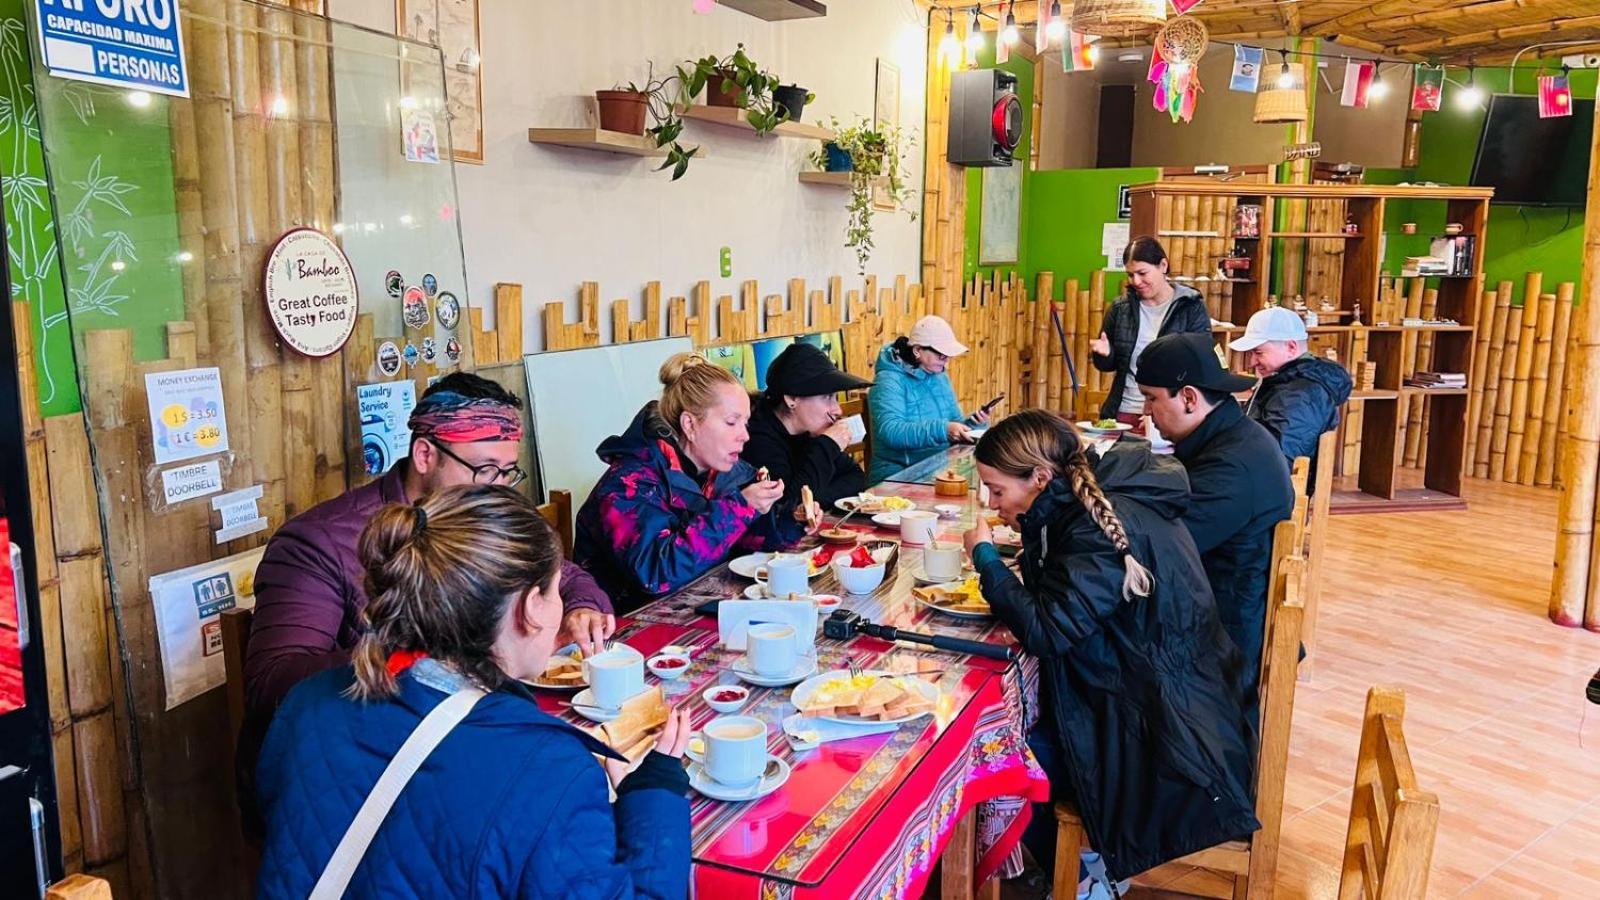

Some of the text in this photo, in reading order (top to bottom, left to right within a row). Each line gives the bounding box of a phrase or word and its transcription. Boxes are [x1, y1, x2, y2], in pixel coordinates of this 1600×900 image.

[47, 14, 174, 52] CAPACIDAD MAXIMA
[97, 50, 180, 85] PERSONAS
[297, 258, 340, 279] Bamboo
[278, 294, 348, 311] Great Coffee
[285, 314, 316, 327] Tasty
[319, 309, 346, 322] Food
[158, 373, 218, 386] MONEY EXCHANGE
[359, 386, 392, 398] Laundry
[198, 408, 217, 420] 3.50
[360, 401, 389, 412] Service
[176, 433, 182, 444] 1
[200, 428, 221, 440] 3.80
[172, 465, 207, 481] TIMBRE
[167, 479, 217, 497] DOORBELL
[226, 512, 257, 527] DOORBELL
